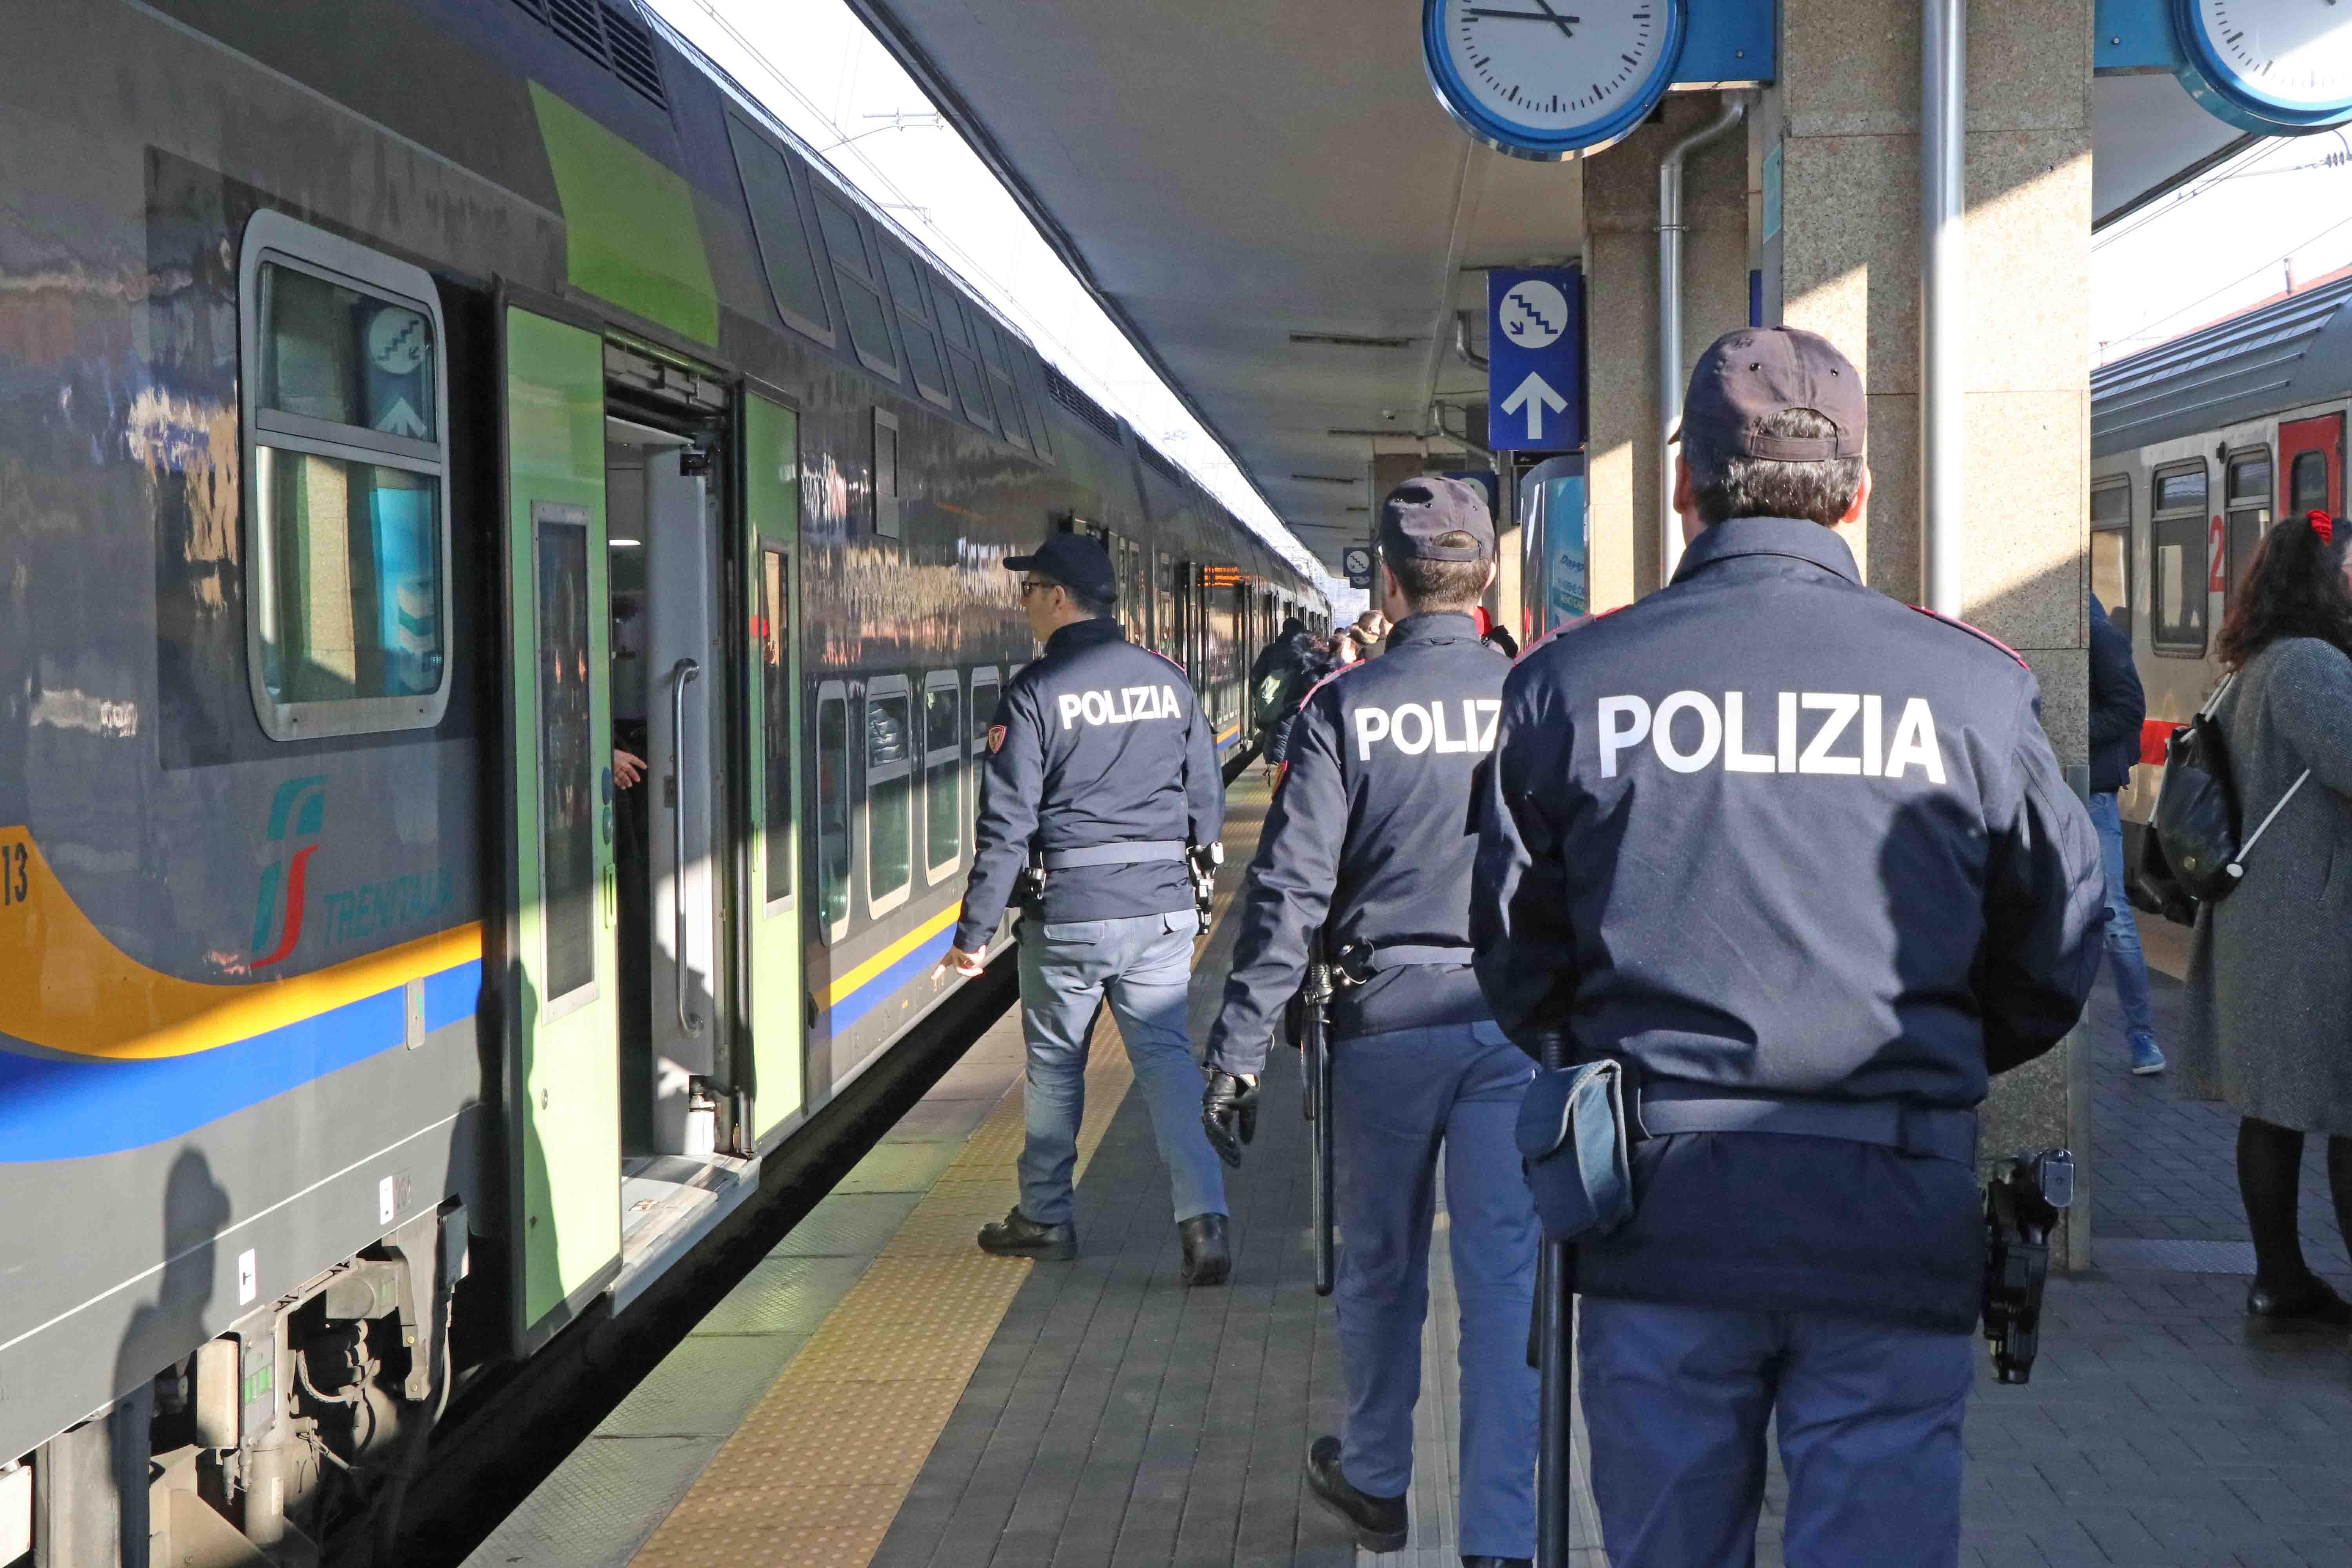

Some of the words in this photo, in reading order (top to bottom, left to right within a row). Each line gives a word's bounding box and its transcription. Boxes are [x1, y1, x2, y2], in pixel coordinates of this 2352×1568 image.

[2209, 514, 2225, 592] 2
[1058, 685, 1181, 730] POLIZIA
[1354, 699, 1502, 761] POLIZ
[1598, 690, 1946, 784] POLIZIA
[2, 843, 27, 906] 13
